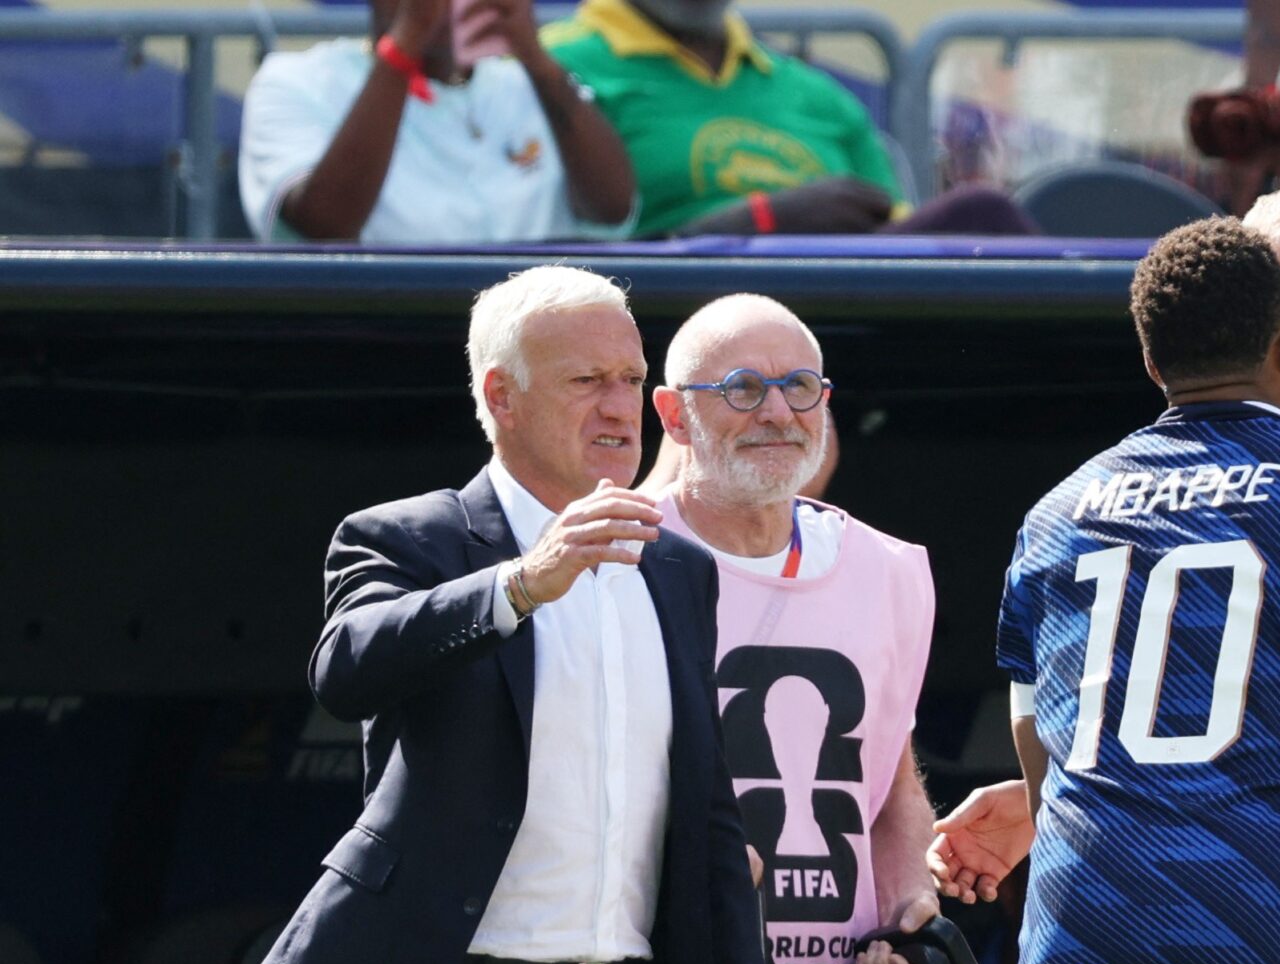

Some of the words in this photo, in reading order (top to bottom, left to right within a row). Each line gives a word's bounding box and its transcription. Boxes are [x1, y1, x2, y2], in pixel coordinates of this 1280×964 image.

[1064, 539, 1268, 772] 10
[774, 869, 840, 898] FIFA
[767, 936, 825, 958] RLD
[829, 936, 857, 958] CU
